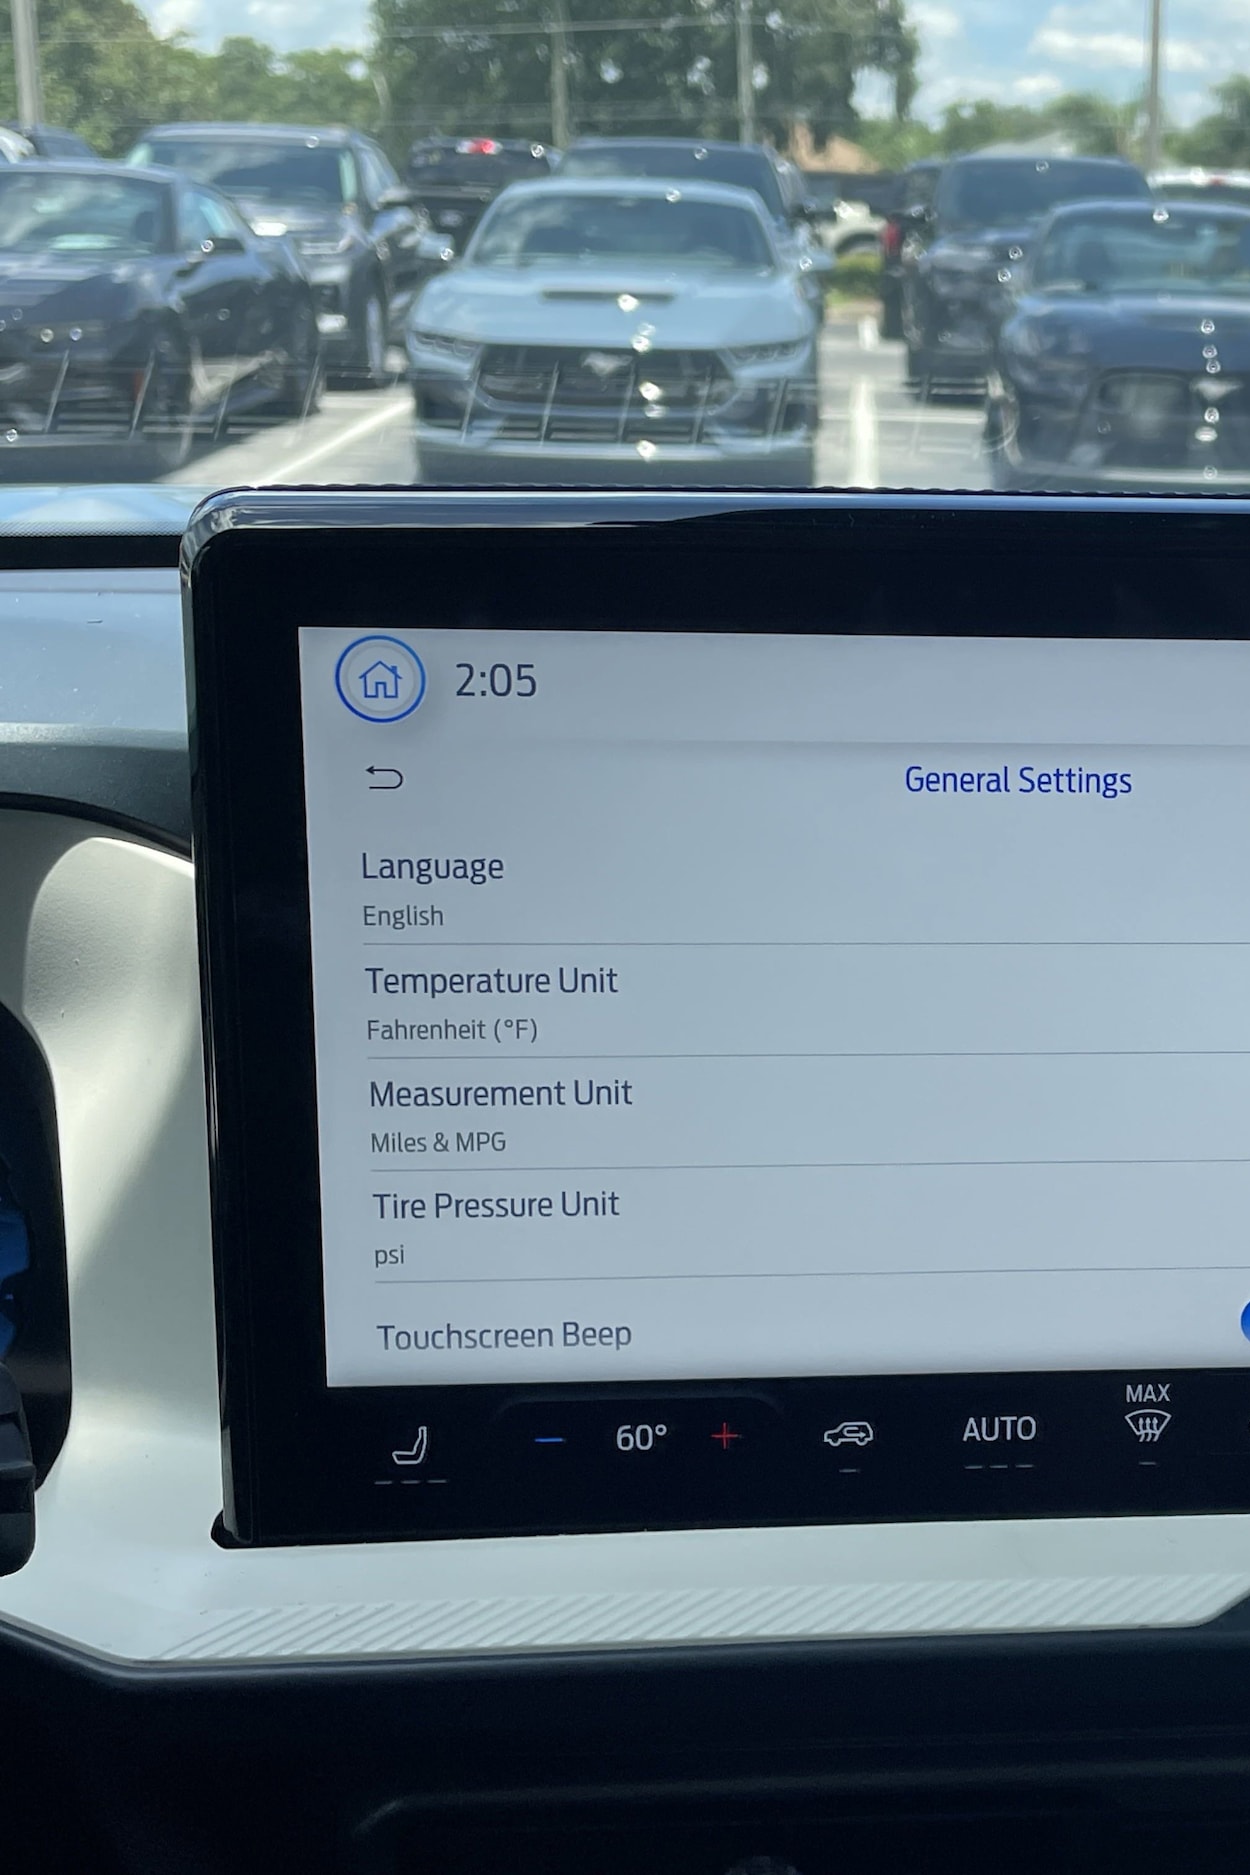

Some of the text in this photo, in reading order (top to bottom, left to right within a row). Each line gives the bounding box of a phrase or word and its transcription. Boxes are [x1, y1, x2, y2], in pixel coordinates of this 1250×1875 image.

[455, 662, 537, 697] 2:05
[905, 765, 1132, 799] General Settings
[362, 852, 504, 885] Language
[363, 904, 444, 931] English
[364, 966, 619, 999] Temperature Unit
[367, 1018, 538, 1044] Fahrenheit (°F)
[370, 1079, 633, 1108] Measurement Unit
[371, 1131, 506, 1153] Miles & MPG
[372, 1190, 620, 1219] Tire Pressure Unit
[374, 1244, 405, 1269] psi
[375, 1321, 632, 1351] Touchscreen Beep
[1126, 1383, 1171, 1403] MAX
[616, 1423, 668, 1451] 60°
[962, 1415, 1037, 1442] AUTO
